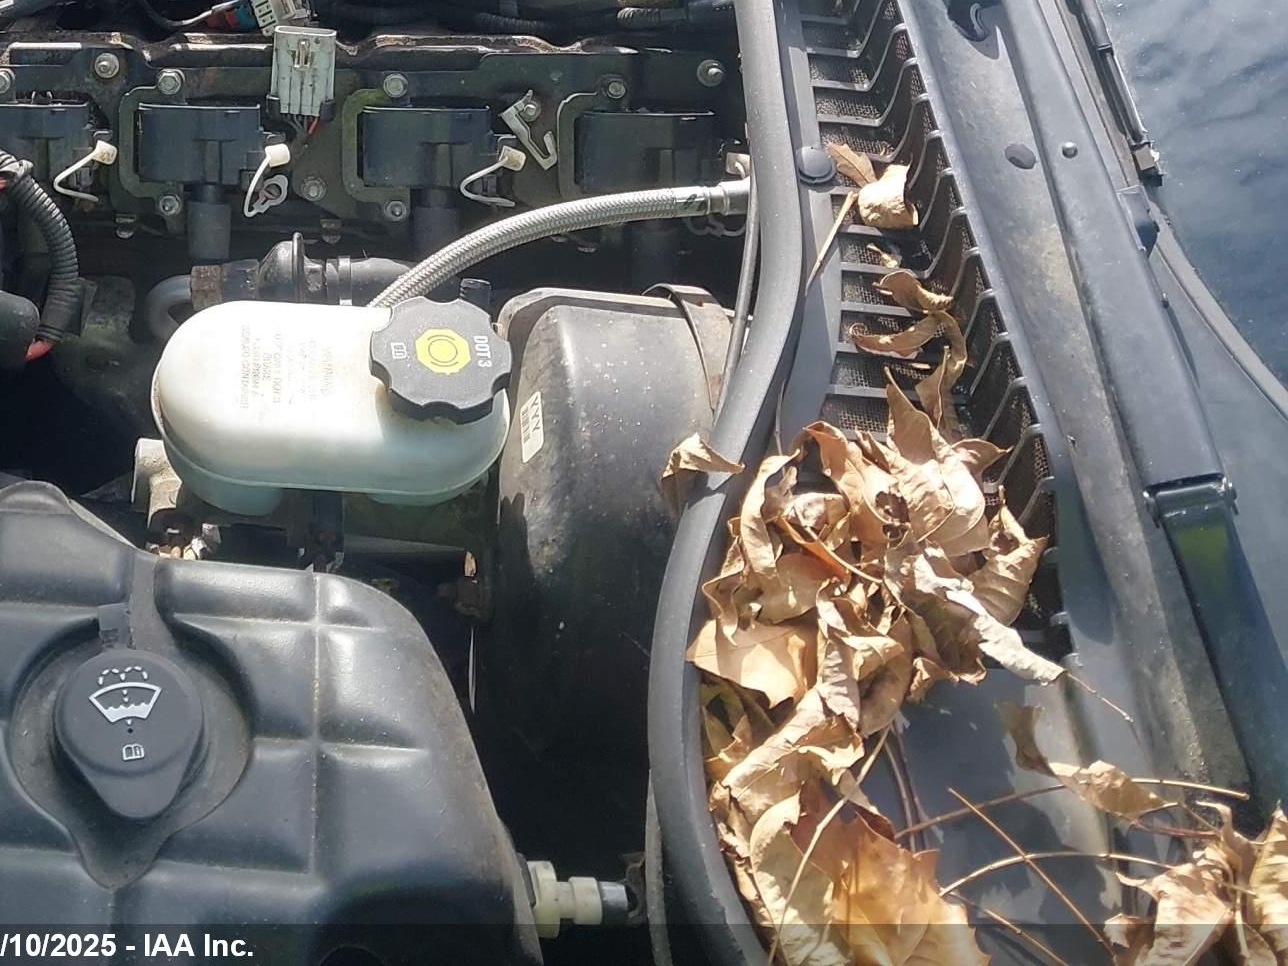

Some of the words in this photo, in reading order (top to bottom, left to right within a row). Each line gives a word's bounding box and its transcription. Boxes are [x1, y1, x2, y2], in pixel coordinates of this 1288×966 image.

[473, 335, 491, 359] DOT
[478, 359, 493, 368] 3
[530, 394, 541, 433] YYY
